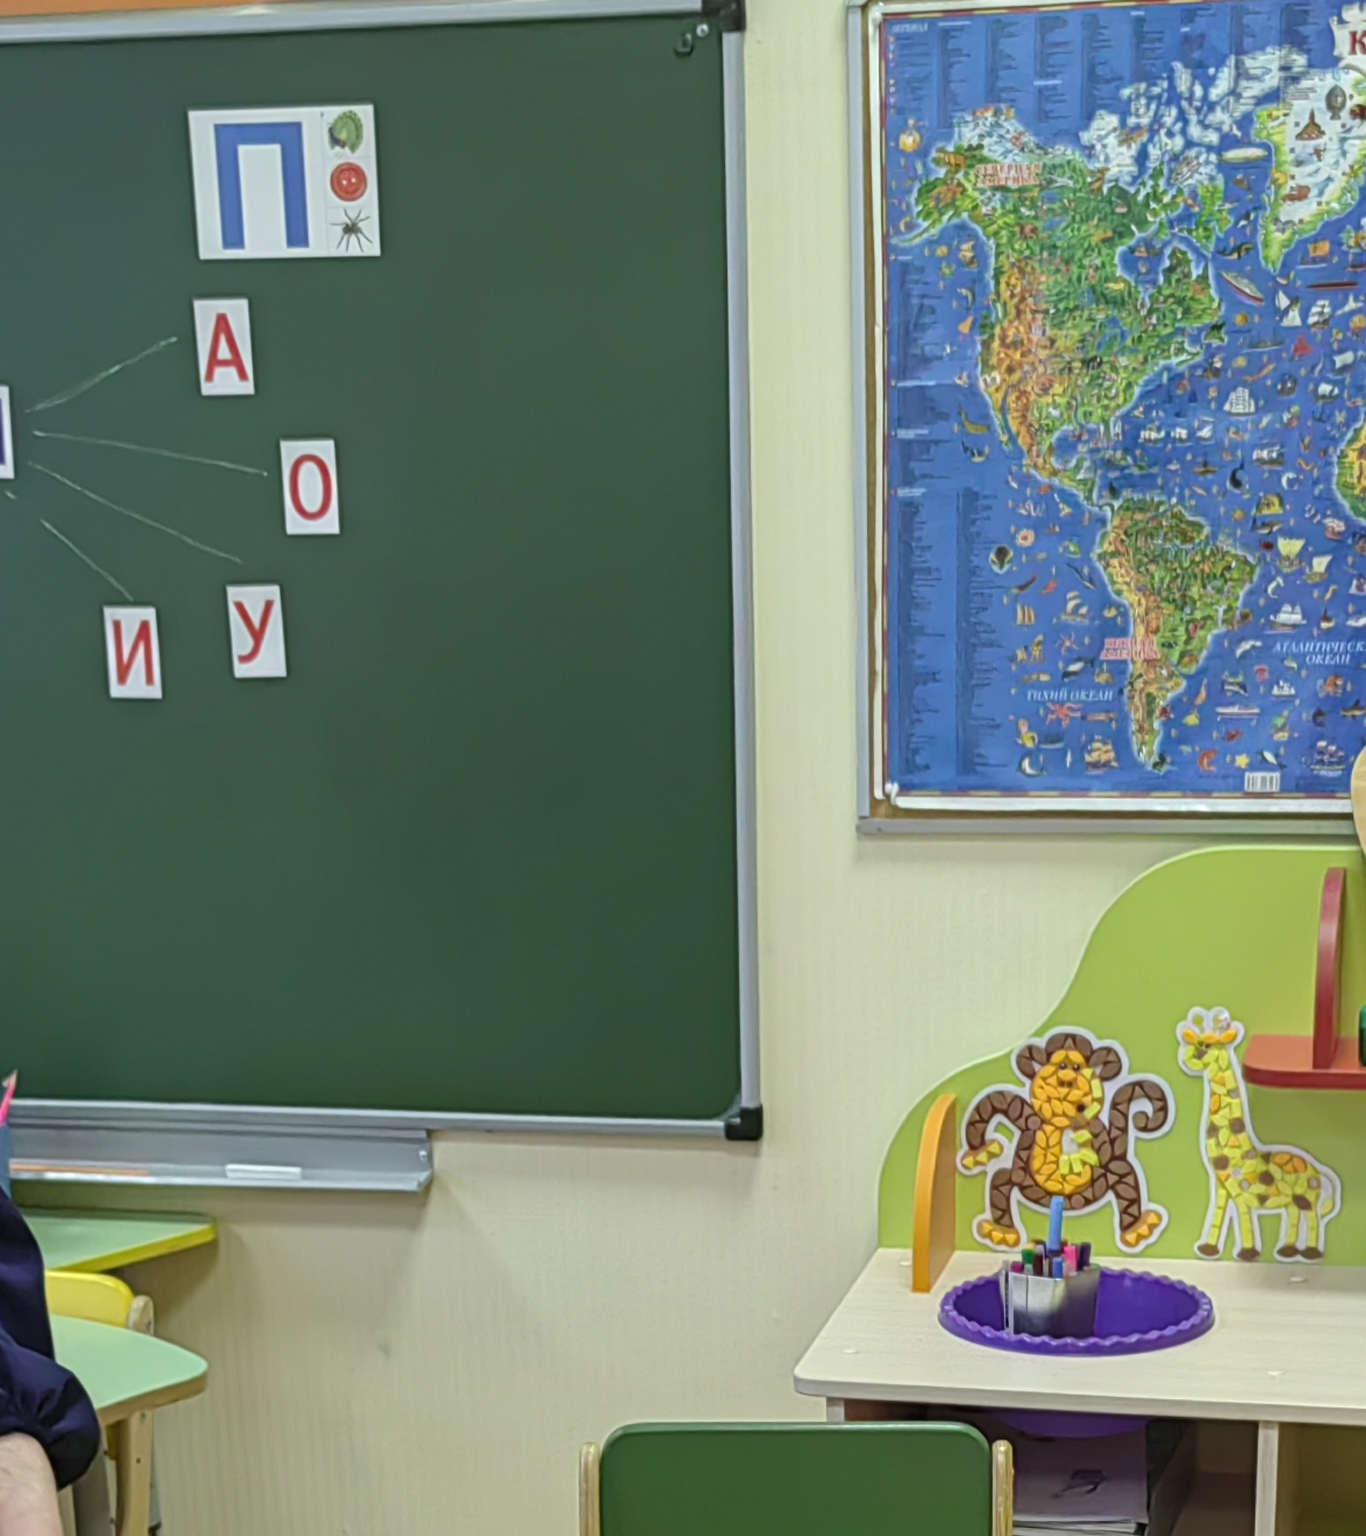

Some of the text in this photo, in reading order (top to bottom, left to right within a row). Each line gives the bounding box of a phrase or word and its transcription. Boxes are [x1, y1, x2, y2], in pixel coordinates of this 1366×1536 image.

[212, 121, 310, 250] П
[203, 312, 249, 383] А
[288, 453, 333, 521] О
[111, 619, 156, 687] И
[232, 599, 275, 664] У
[1305, 654, 1351, 666] ОКЕАН
[1026, 687, 1114, 702] ТИХИЙ ОКЕАН
